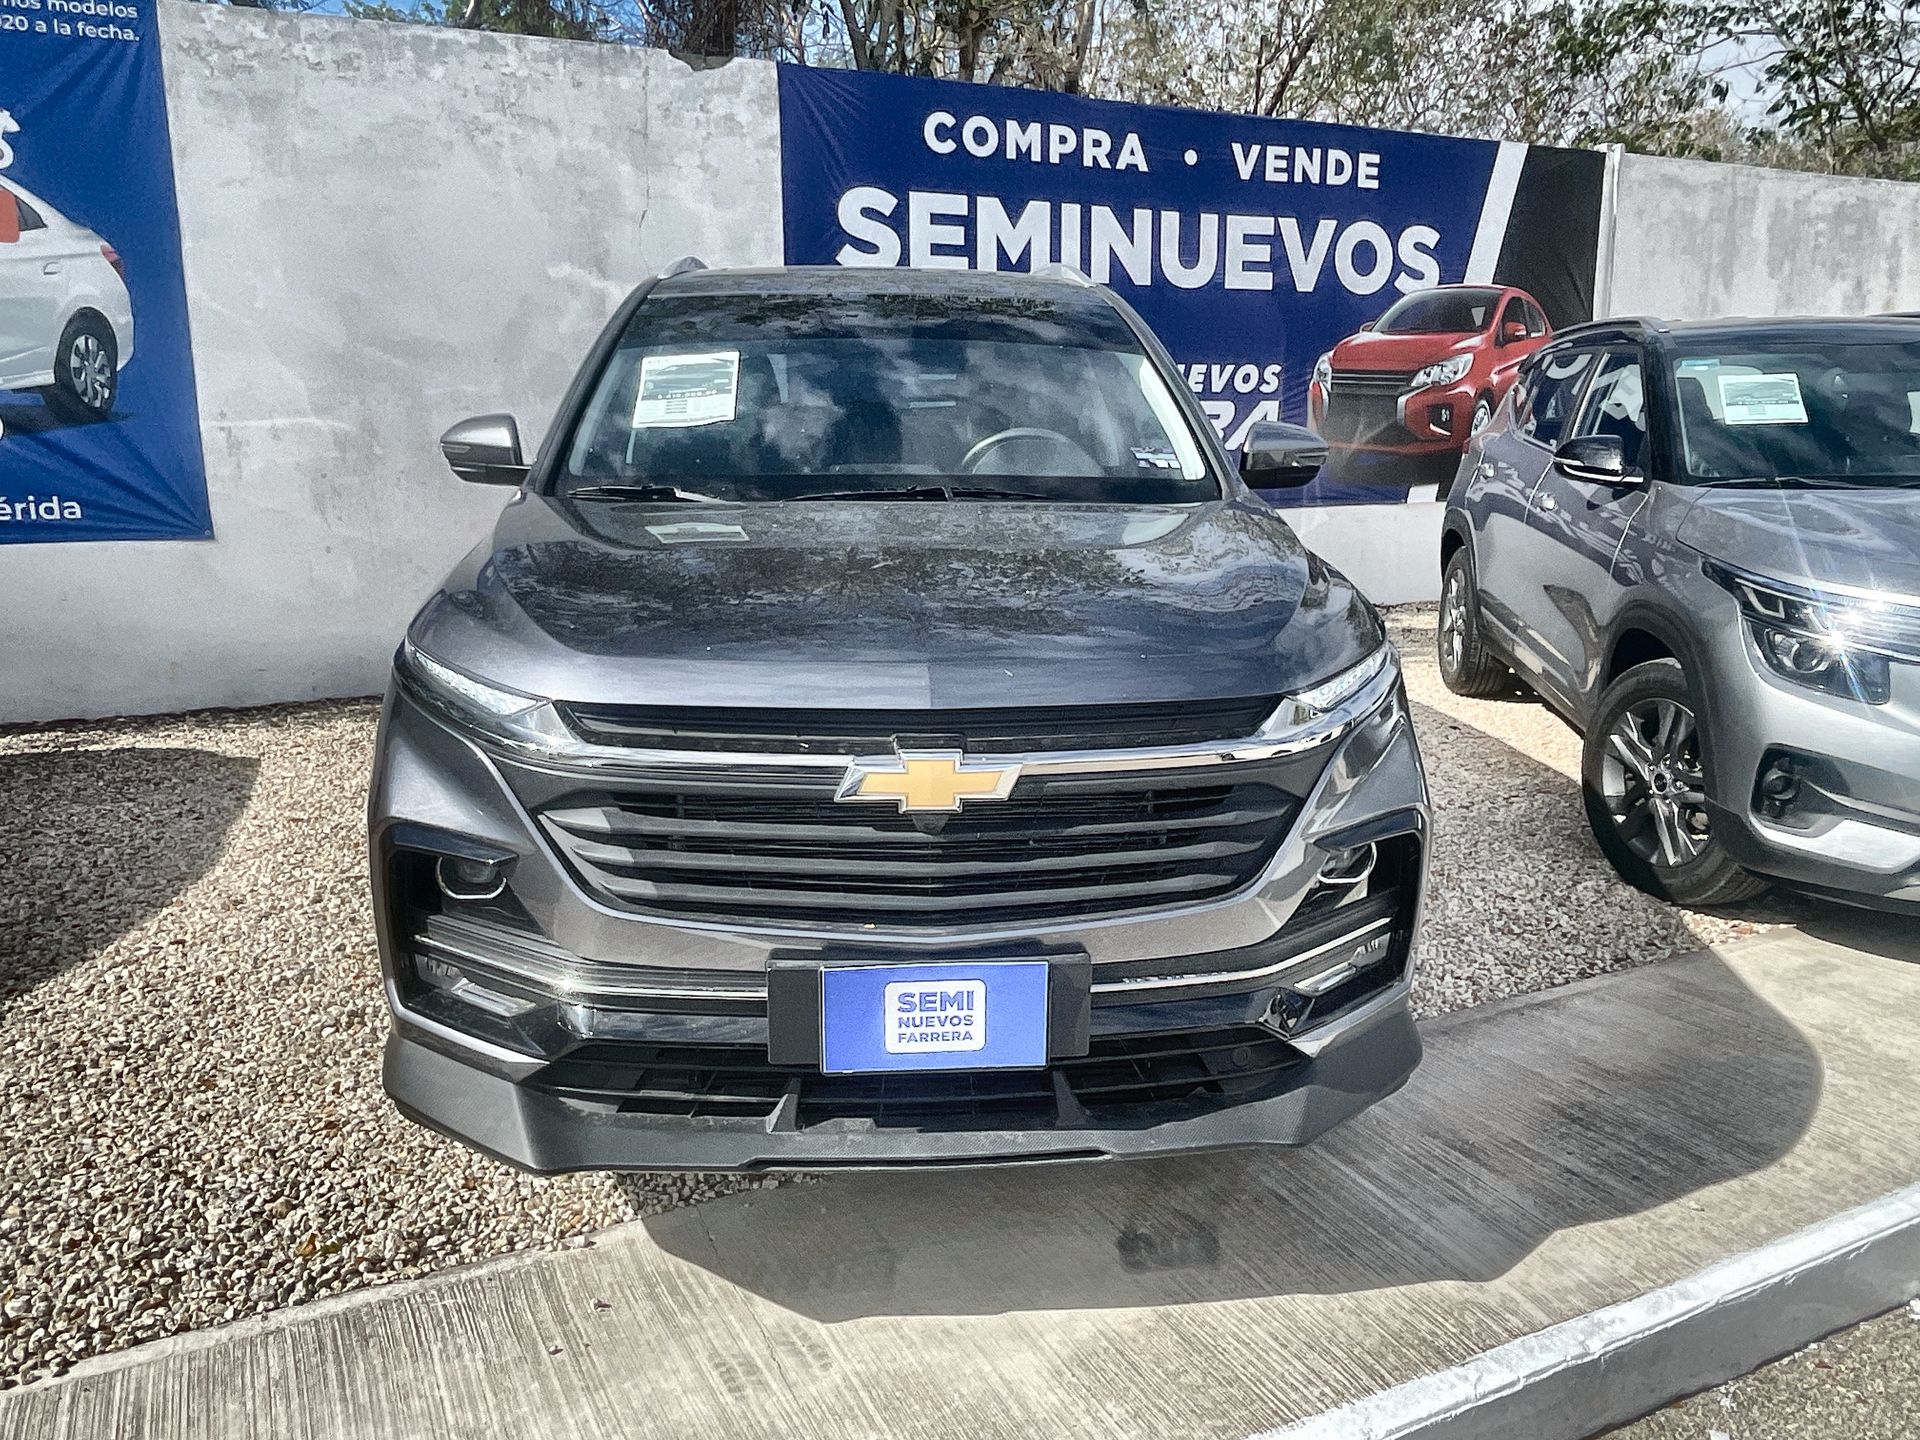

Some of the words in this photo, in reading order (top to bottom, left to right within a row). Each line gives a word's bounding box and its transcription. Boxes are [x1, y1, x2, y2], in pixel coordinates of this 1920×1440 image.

[48, 0, 138, 19] modelos
[0, 14, 29, 32] 20
[35, 20, 47, 33] a
[53, 18, 71, 36] la
[77, 21, 140, 41] fecha.
[922, 110, 1148, 173] COMPRA
[1231, 142, 1381, 190] VENDE
[835, 186, 1441, 296] SEMINUEVOS
[897, 990, 975, 1013] SEMI
[897, 1014, 974, 1029] NUEVOS
[897, 1030, 974, 1043] FARRERA
